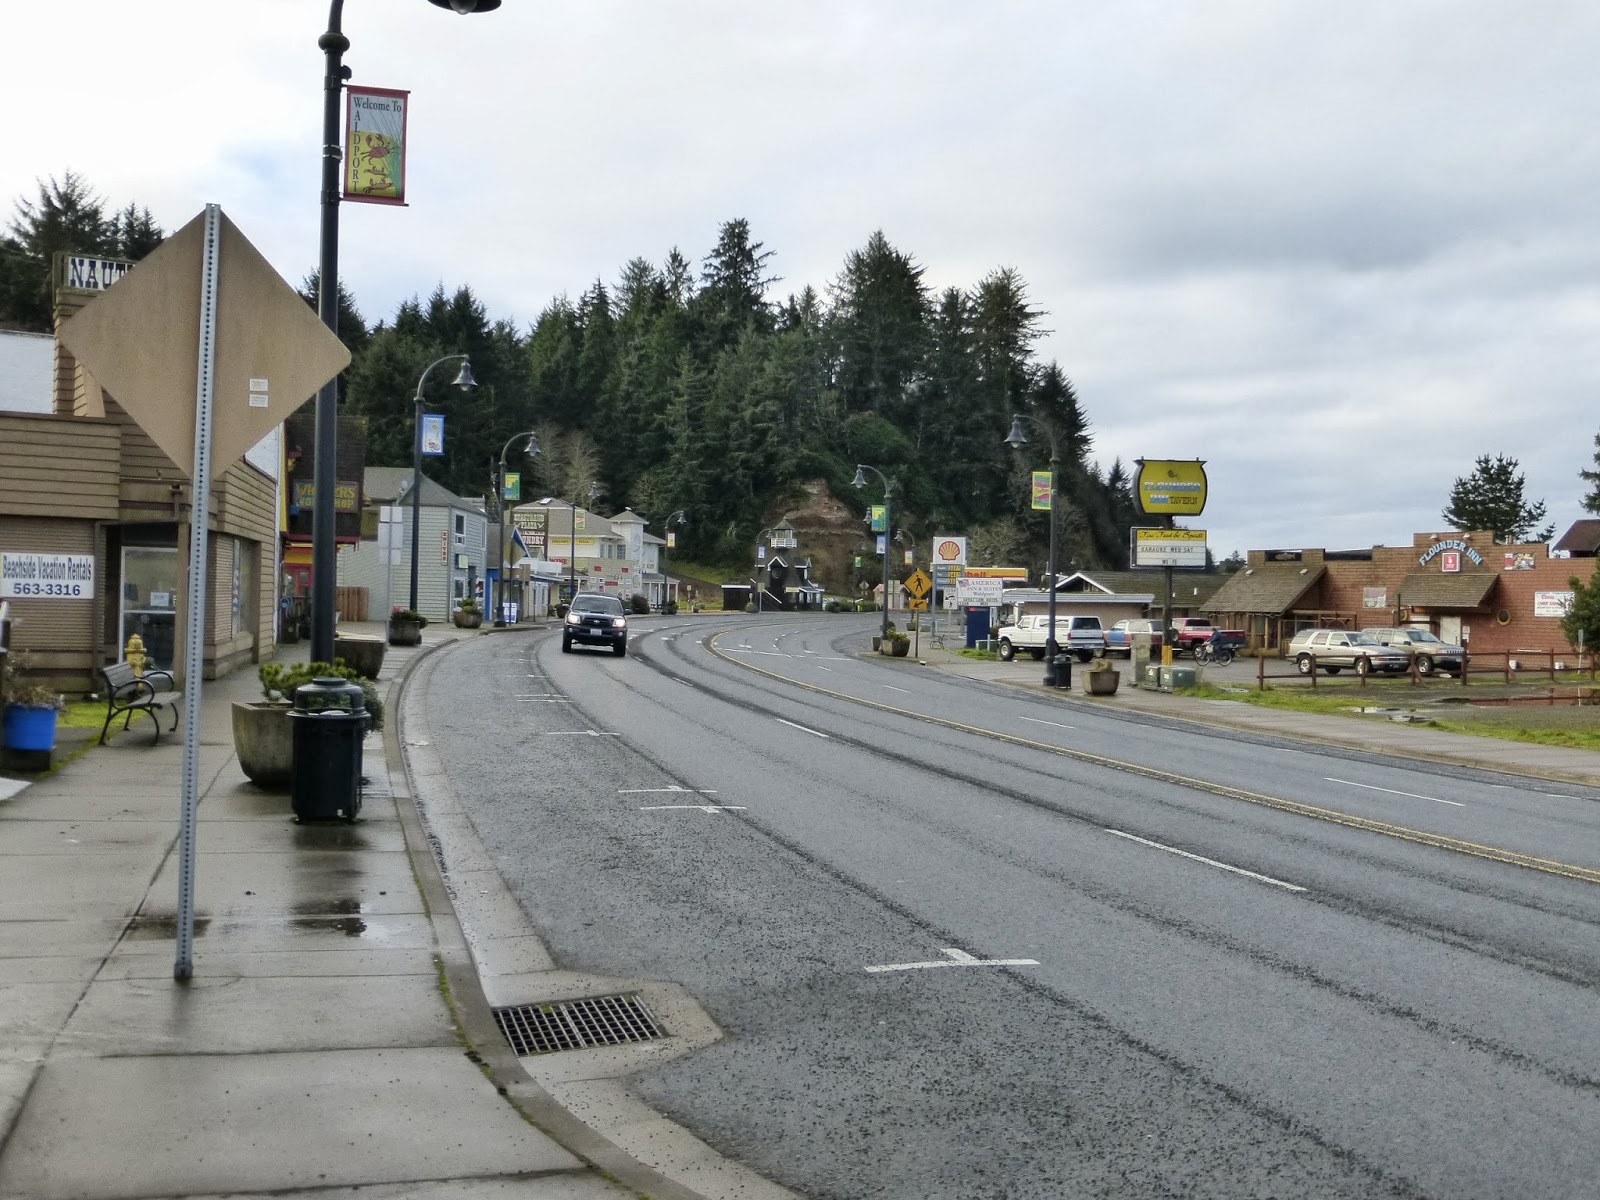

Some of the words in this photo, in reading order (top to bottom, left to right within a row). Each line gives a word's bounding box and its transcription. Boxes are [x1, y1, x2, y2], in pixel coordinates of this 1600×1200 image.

[353, 97, 390, 111] Welcome
[391, 100, 402, 112] To
[70, 258, 134, 289] NAUT
[1144, 482, 1201, 491] FLOUNDER
[1182, 531, 1204, 540] Spirits
[1419, 540, 1467, 566] FLOUNDER
[1466, 547, 1483, 566] INN
[3, 555, 36, 579] Beachside
[38, 556, 66, 580] Vacation
[67, 557, 92, 581] Rentals
[13, 583, 81, 596] 563-3316
